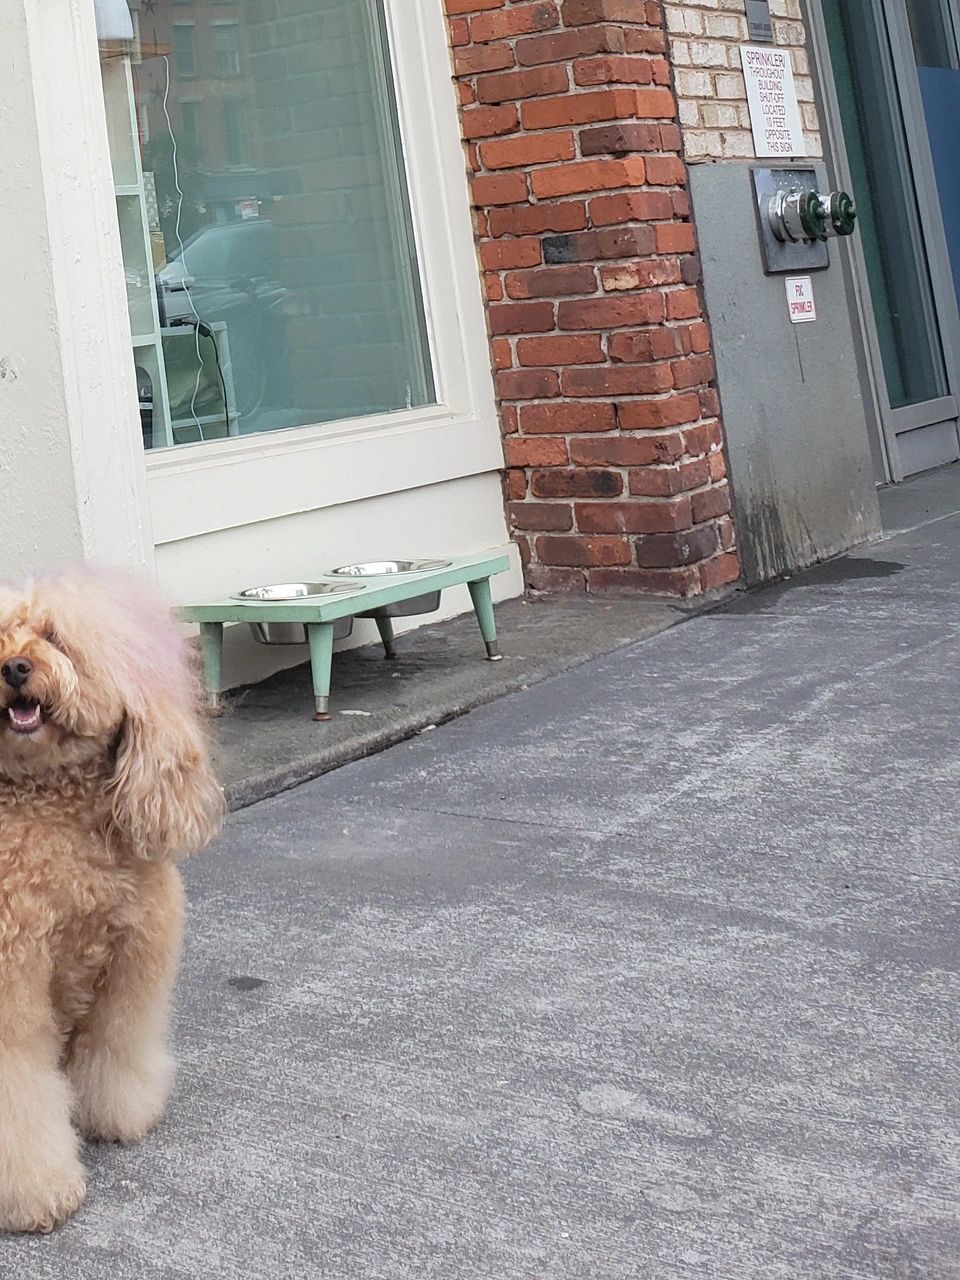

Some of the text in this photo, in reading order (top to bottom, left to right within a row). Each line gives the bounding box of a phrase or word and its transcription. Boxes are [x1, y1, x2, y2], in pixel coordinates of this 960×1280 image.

[749, 66, 785, 80] THROUGHOUT
[758, 79, 782, 91] BUILDING
[759, 92, 784, 104] SHUT-OFF
[762, 104, 786, 115] LOCATED
[764, 129, 791, 140] OPPOSITE
[766, 141, 793, 153] THIS SIGN
